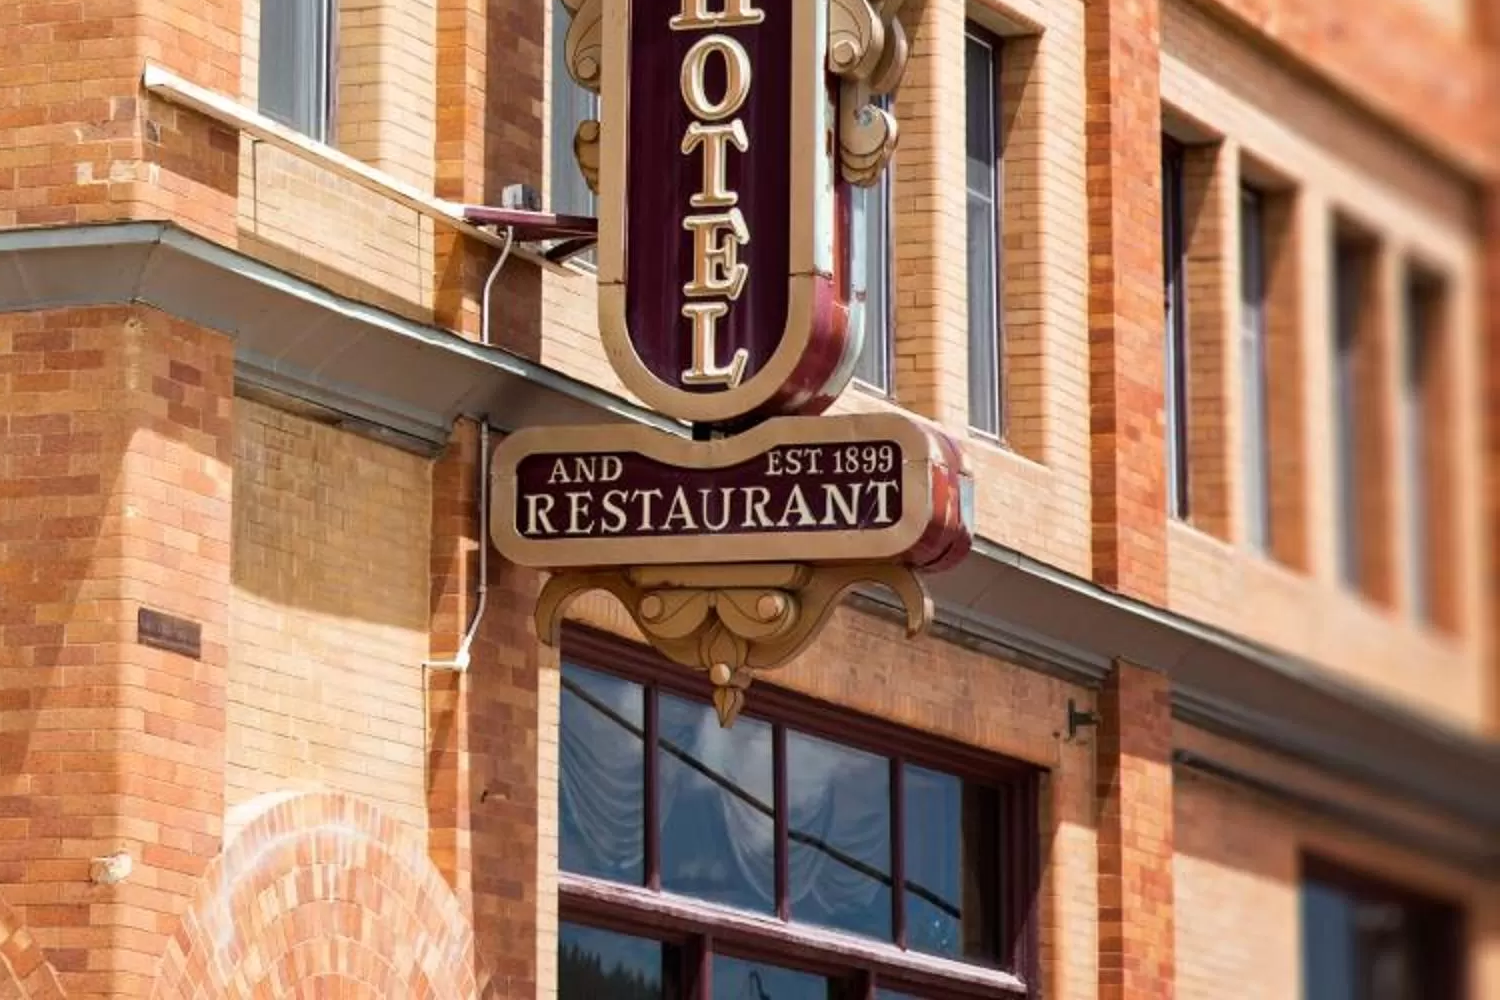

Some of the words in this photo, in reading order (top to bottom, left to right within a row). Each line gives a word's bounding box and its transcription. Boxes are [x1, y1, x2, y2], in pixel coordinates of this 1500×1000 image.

[548, 456, 624, 484] AND
[832, 445, 894, 474] 1899
[523, 479, 899, 535] RESTAURANT
